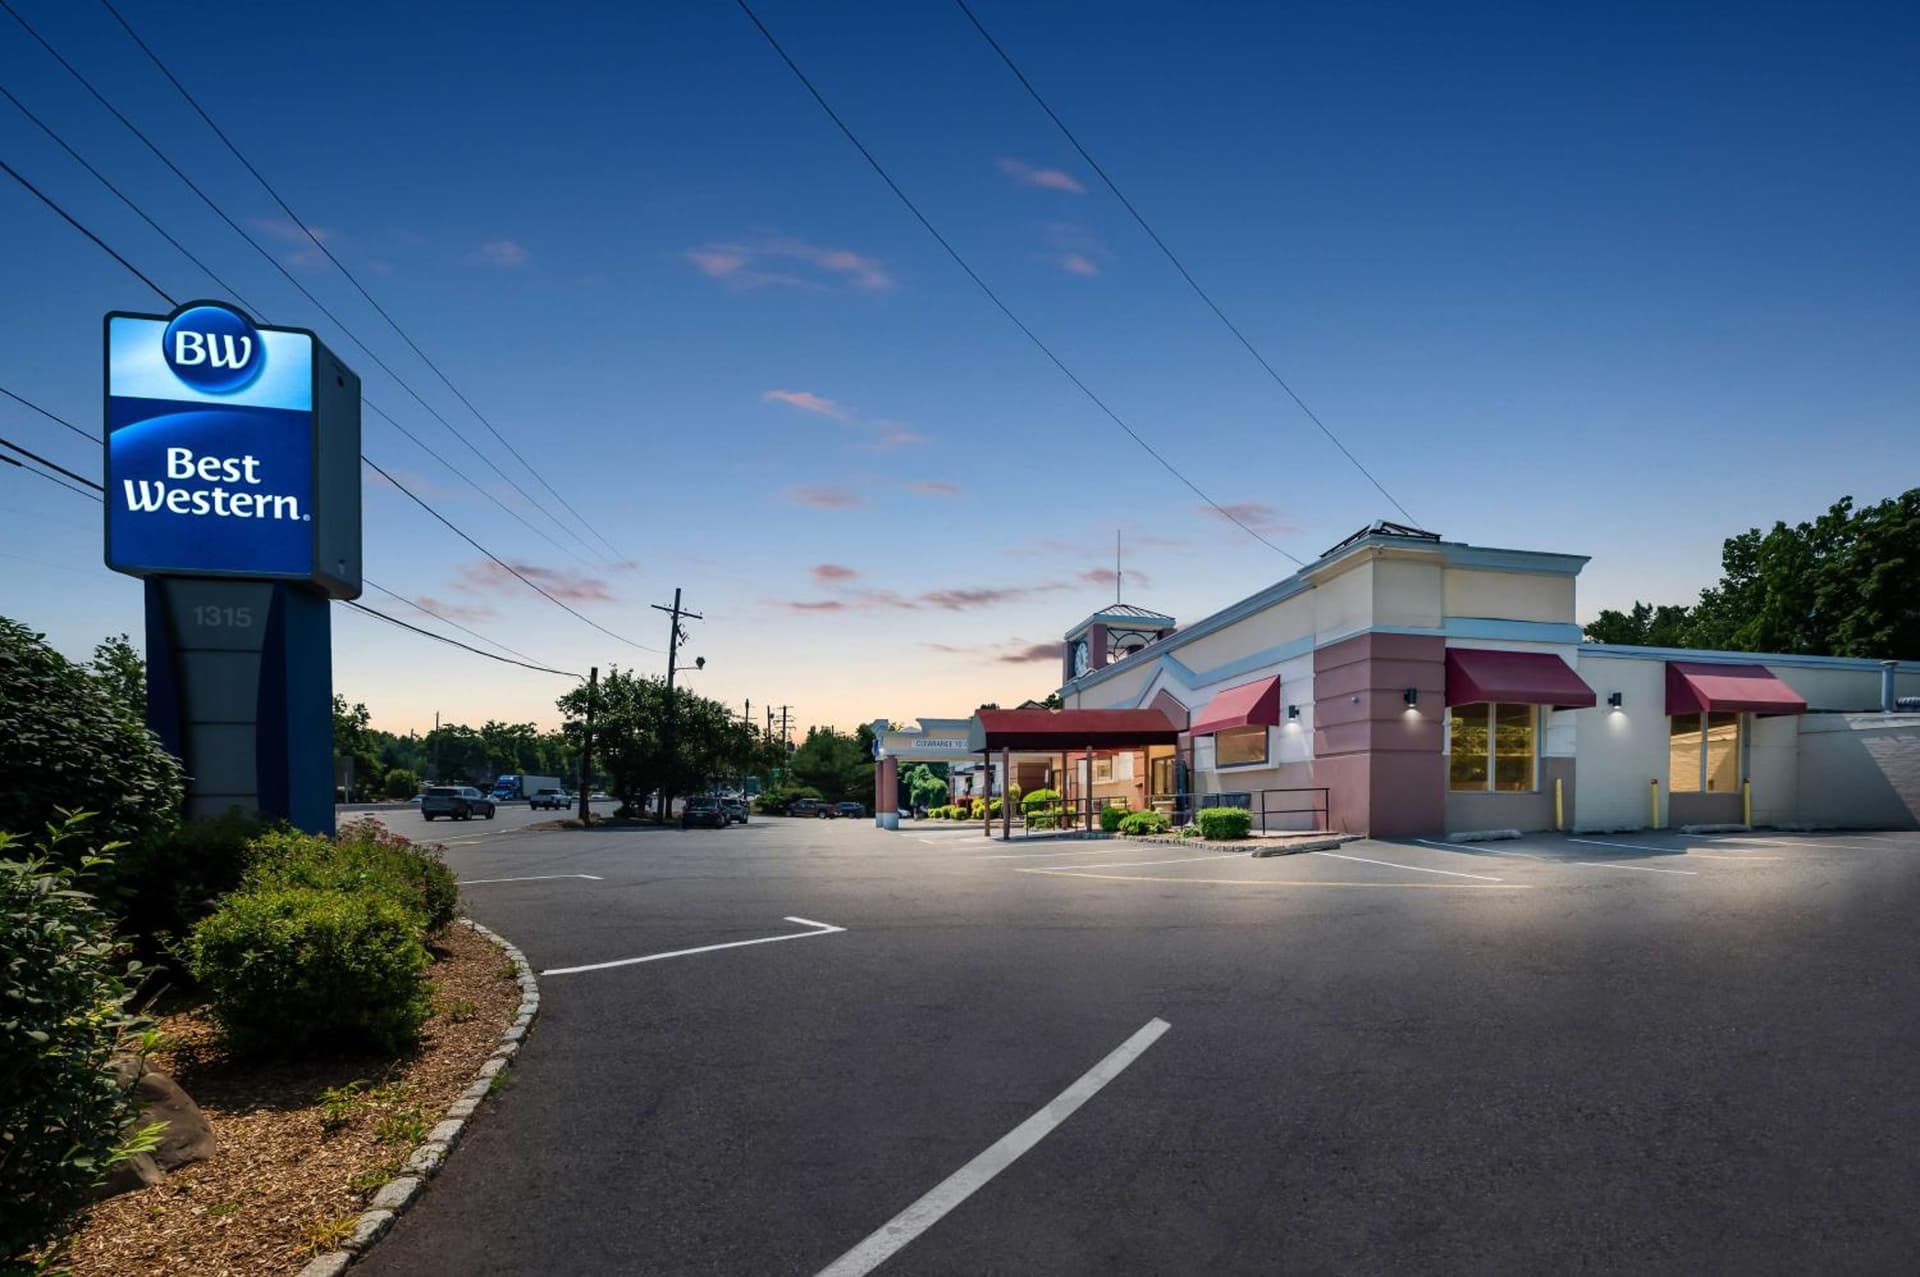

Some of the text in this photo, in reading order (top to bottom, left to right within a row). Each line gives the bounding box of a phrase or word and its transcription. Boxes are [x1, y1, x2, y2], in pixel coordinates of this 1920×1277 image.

[175, 331, 251, 369] BW
[167, 447, 261, 484] Best
[194, 606, 252, 627] 1315
